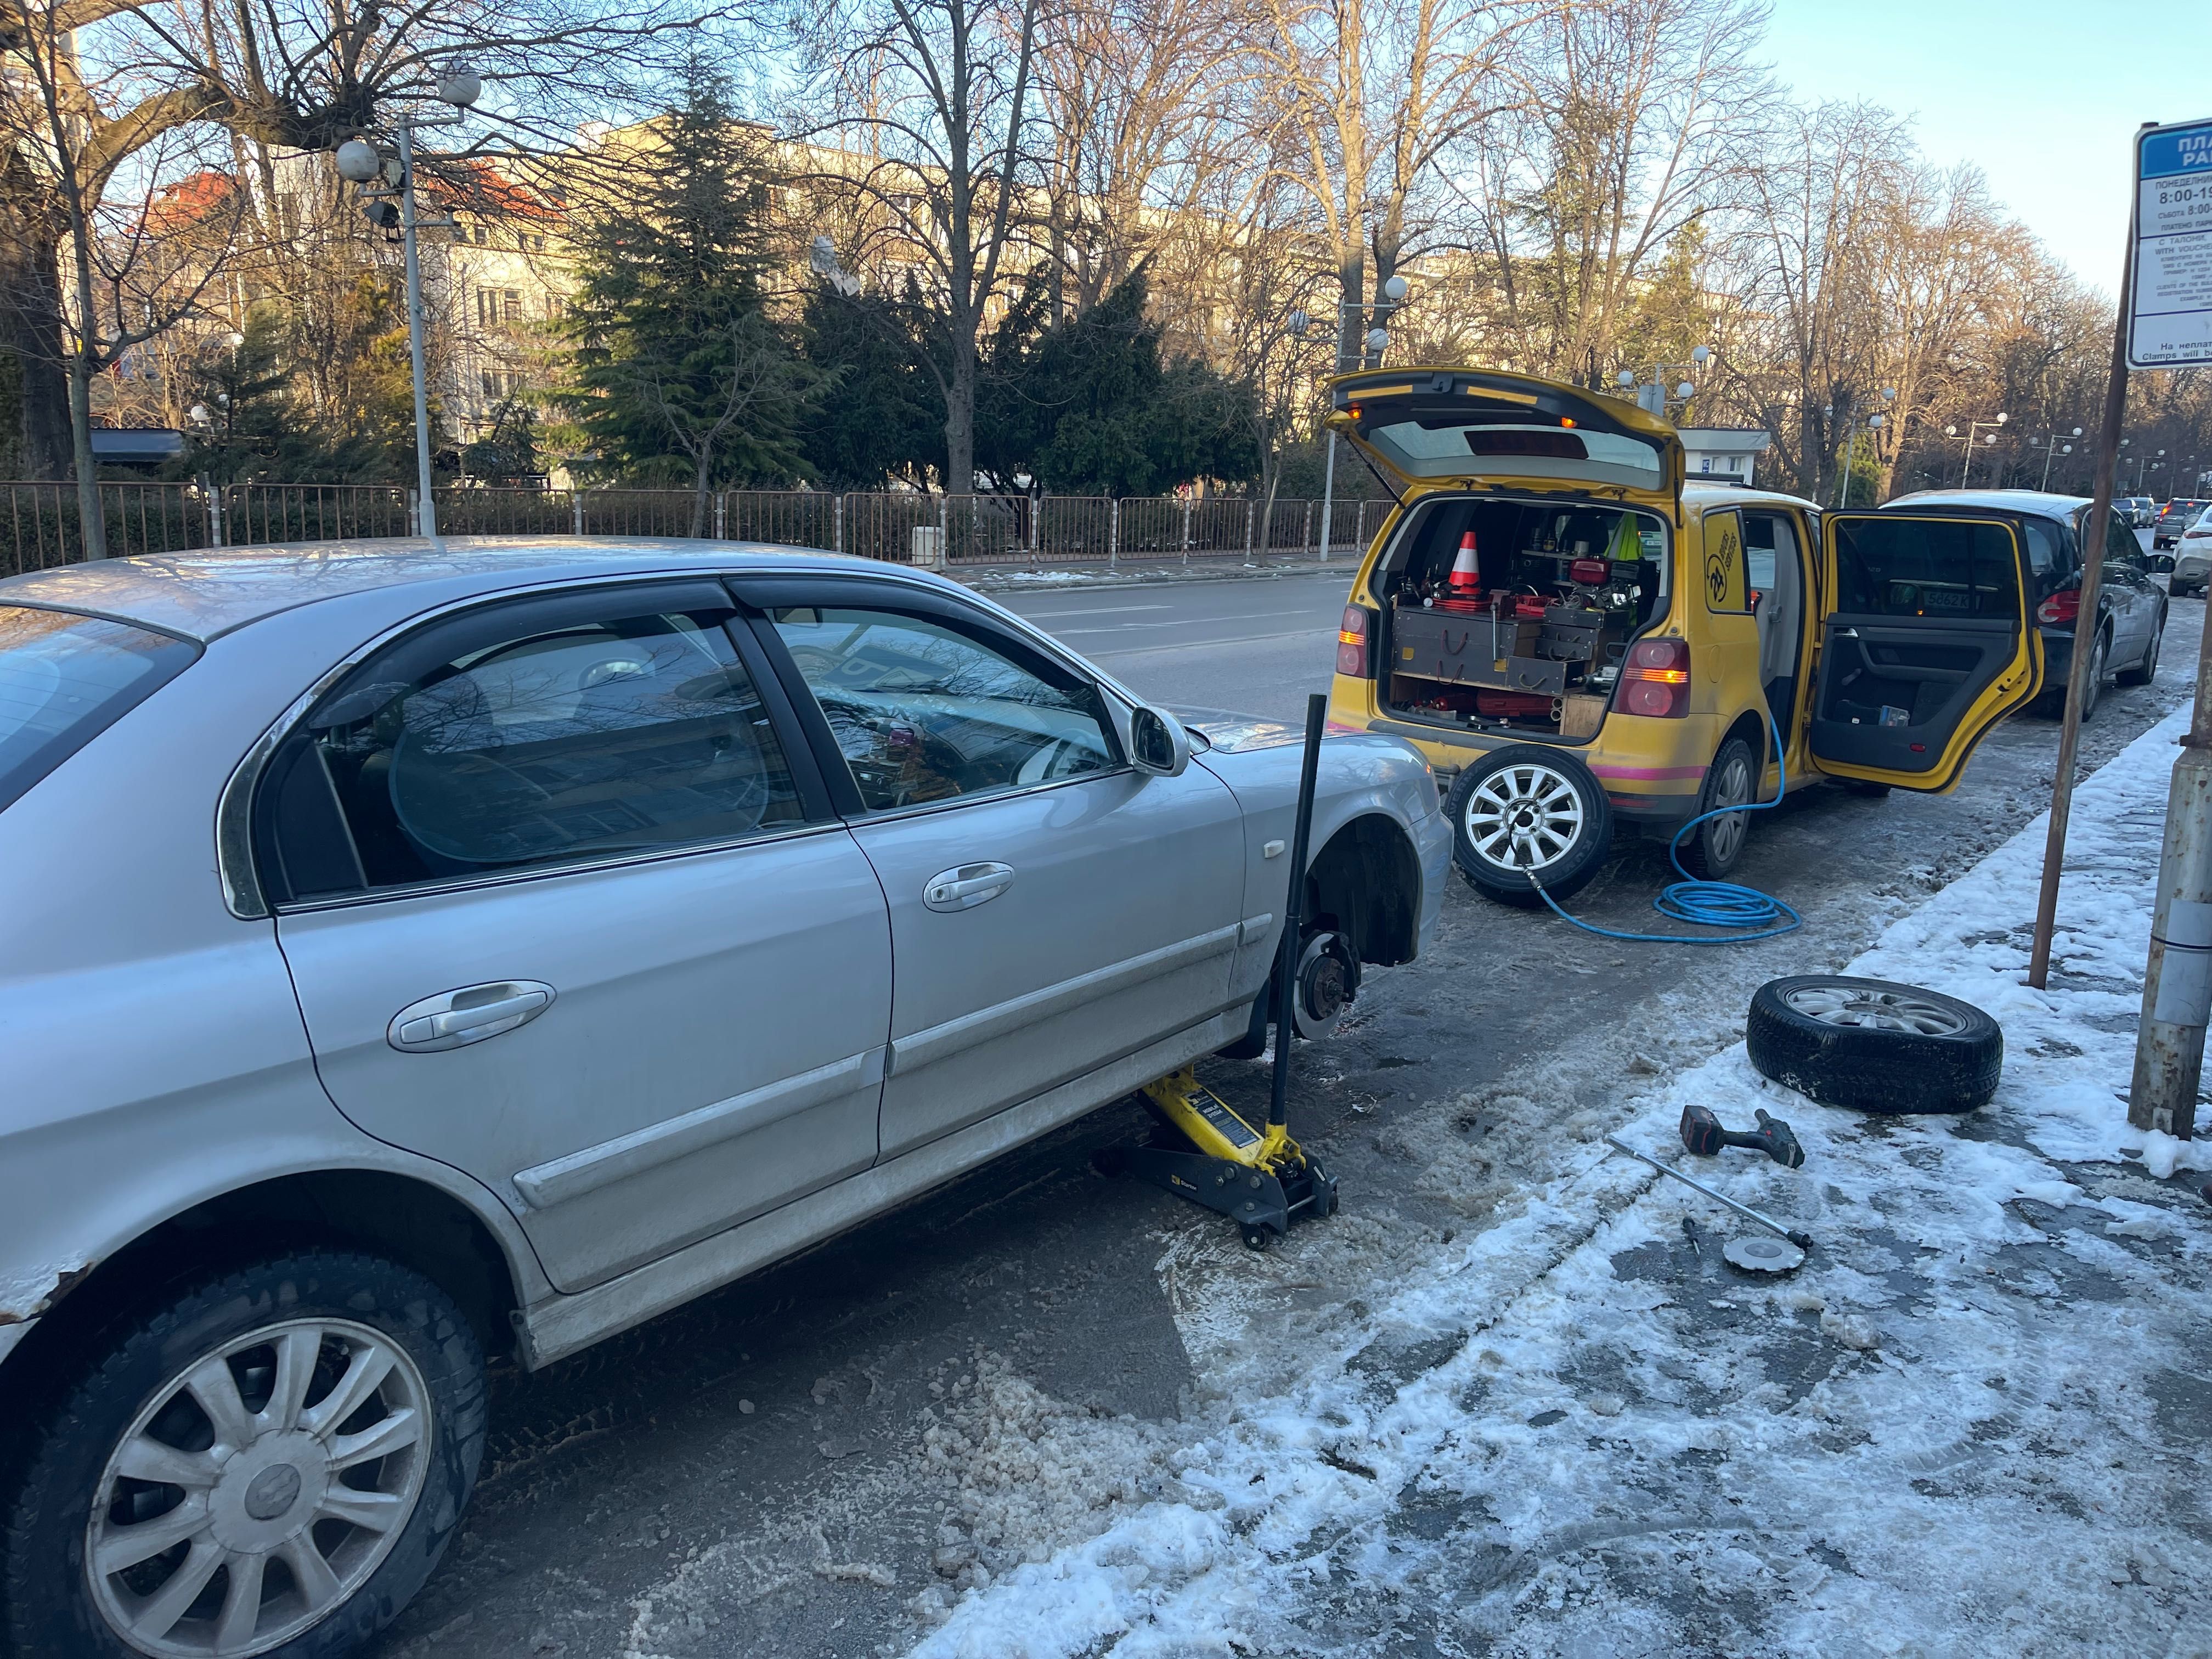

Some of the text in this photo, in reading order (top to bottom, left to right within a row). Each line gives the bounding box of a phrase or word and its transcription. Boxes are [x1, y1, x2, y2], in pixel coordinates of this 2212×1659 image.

[2179, 243, 2212, 252] VOUCHE
[2142, 352, 2177, 361] Clamps
[2182, 349, 2198, 358] will
